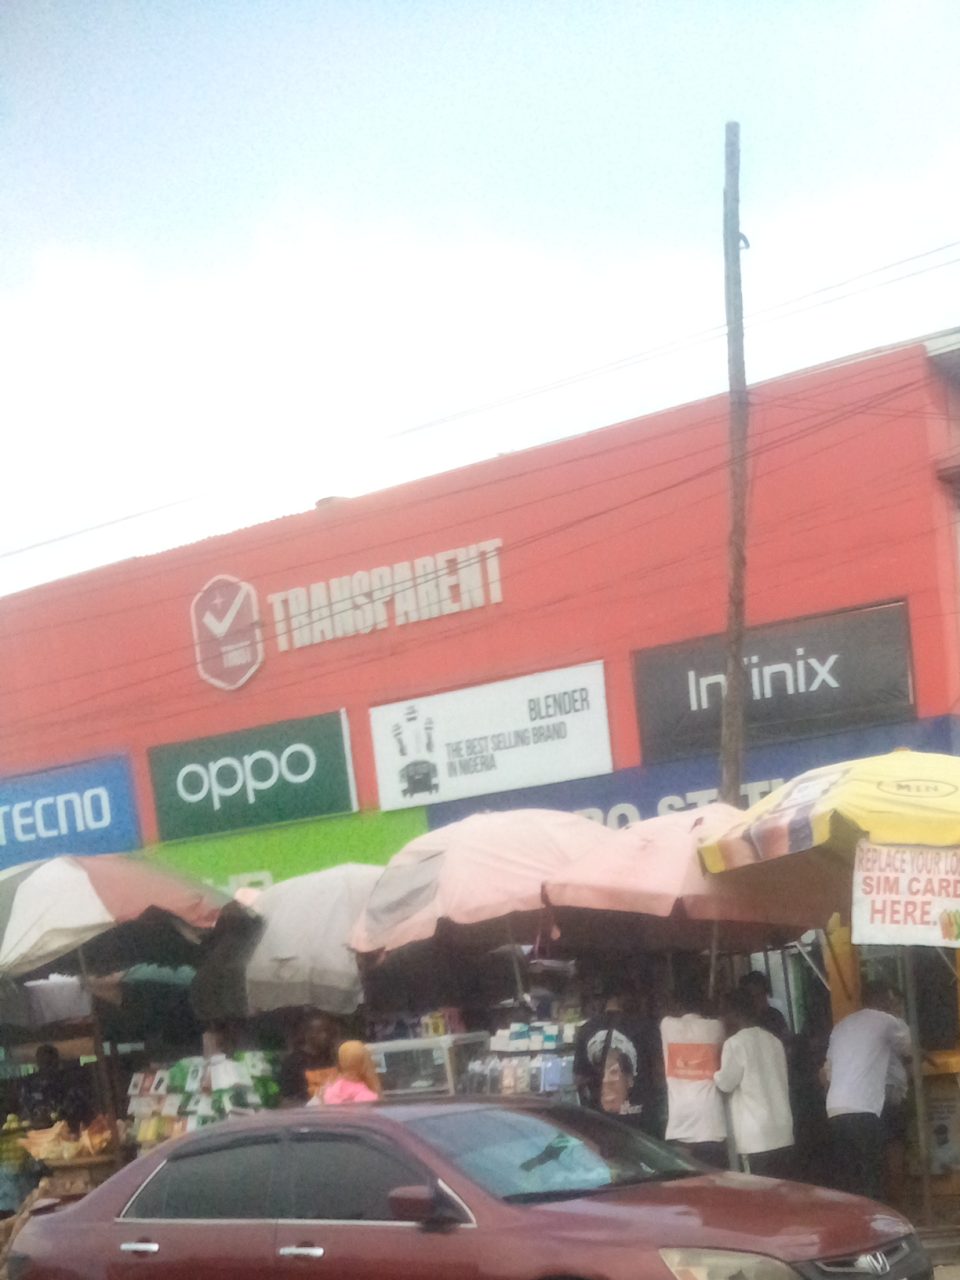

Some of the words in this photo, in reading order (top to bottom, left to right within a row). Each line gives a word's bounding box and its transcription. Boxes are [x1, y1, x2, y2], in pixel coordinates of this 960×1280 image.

[267, 538, 503, 652] TRANSPARENT
[687, 647, 841, 711] Ininix
[528, 687, 590, 721] BLENDER
[445, 741, 464, 761] THE
[465, 736, 489, 757] BEST
[531, 721, 568, 744] BRAND
[176, 743, 316, 811] oppo
[862, 875, 900, 896] SIM
[869, 899, 937, 926] HERE.
